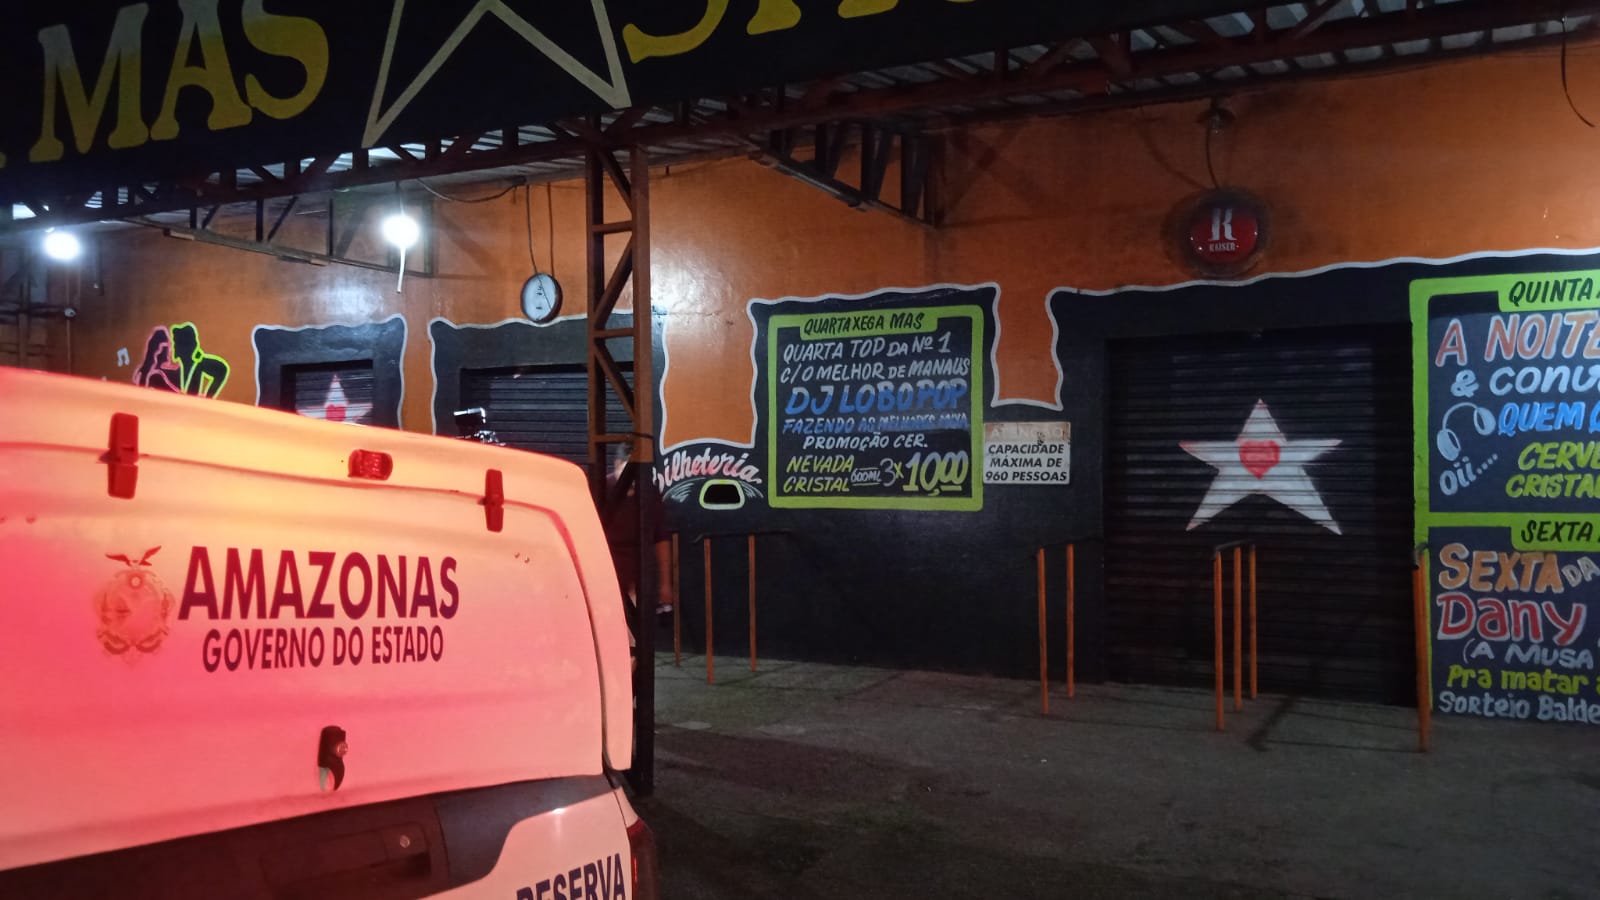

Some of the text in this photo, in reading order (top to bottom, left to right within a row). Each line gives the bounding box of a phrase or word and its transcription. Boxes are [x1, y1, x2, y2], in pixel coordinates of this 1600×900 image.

[1209, 242, 1236, 252] KAISER
[1509, 277, 1594, 307] QUINTA
[803, 312, 926, 336] QUARTA XEGA MAS
[783, 342, 843, 364] QUARTA
[850, 337, 885, 359] TOP
[886, 342, 909, 358] DA
[938, 331, 952, 353] 1
[1435, 318, 1468, 367] A
[816, 362, 885, 382] MELHOR
[887, 366, 907, 379] DE
[908, 357, 970, 378] MANAUS
[785, 378, 968, 416] DJ LOBO POP
[782, 416, 854, 434] FAZENDO
[1498, 402, 1587, 437] QUEM
[803, 431, 928, 451] PROMOÇÃO CER.
[988, 444, 1065, 454] CAPACIDADE
[786, 454, 854, 473] NEVADA
[990, 455, 1063, 468] MÁXIMA DE
[783, 475, 850, 493] CRISTAL
[985, 471, 1067, 481] 960 PESSOAS
[1521, 519, 1594, 544] SEXTA
[1438, 543, 1600, 593] SEXTA DA
[177, 545, 460, 621] AMAZONAS
[1436, 591, 1587, 647] Dany
[202, 624, 444, 673] GOVERNO DO ESTADO
[1501, 668, 1589, 695] matar
